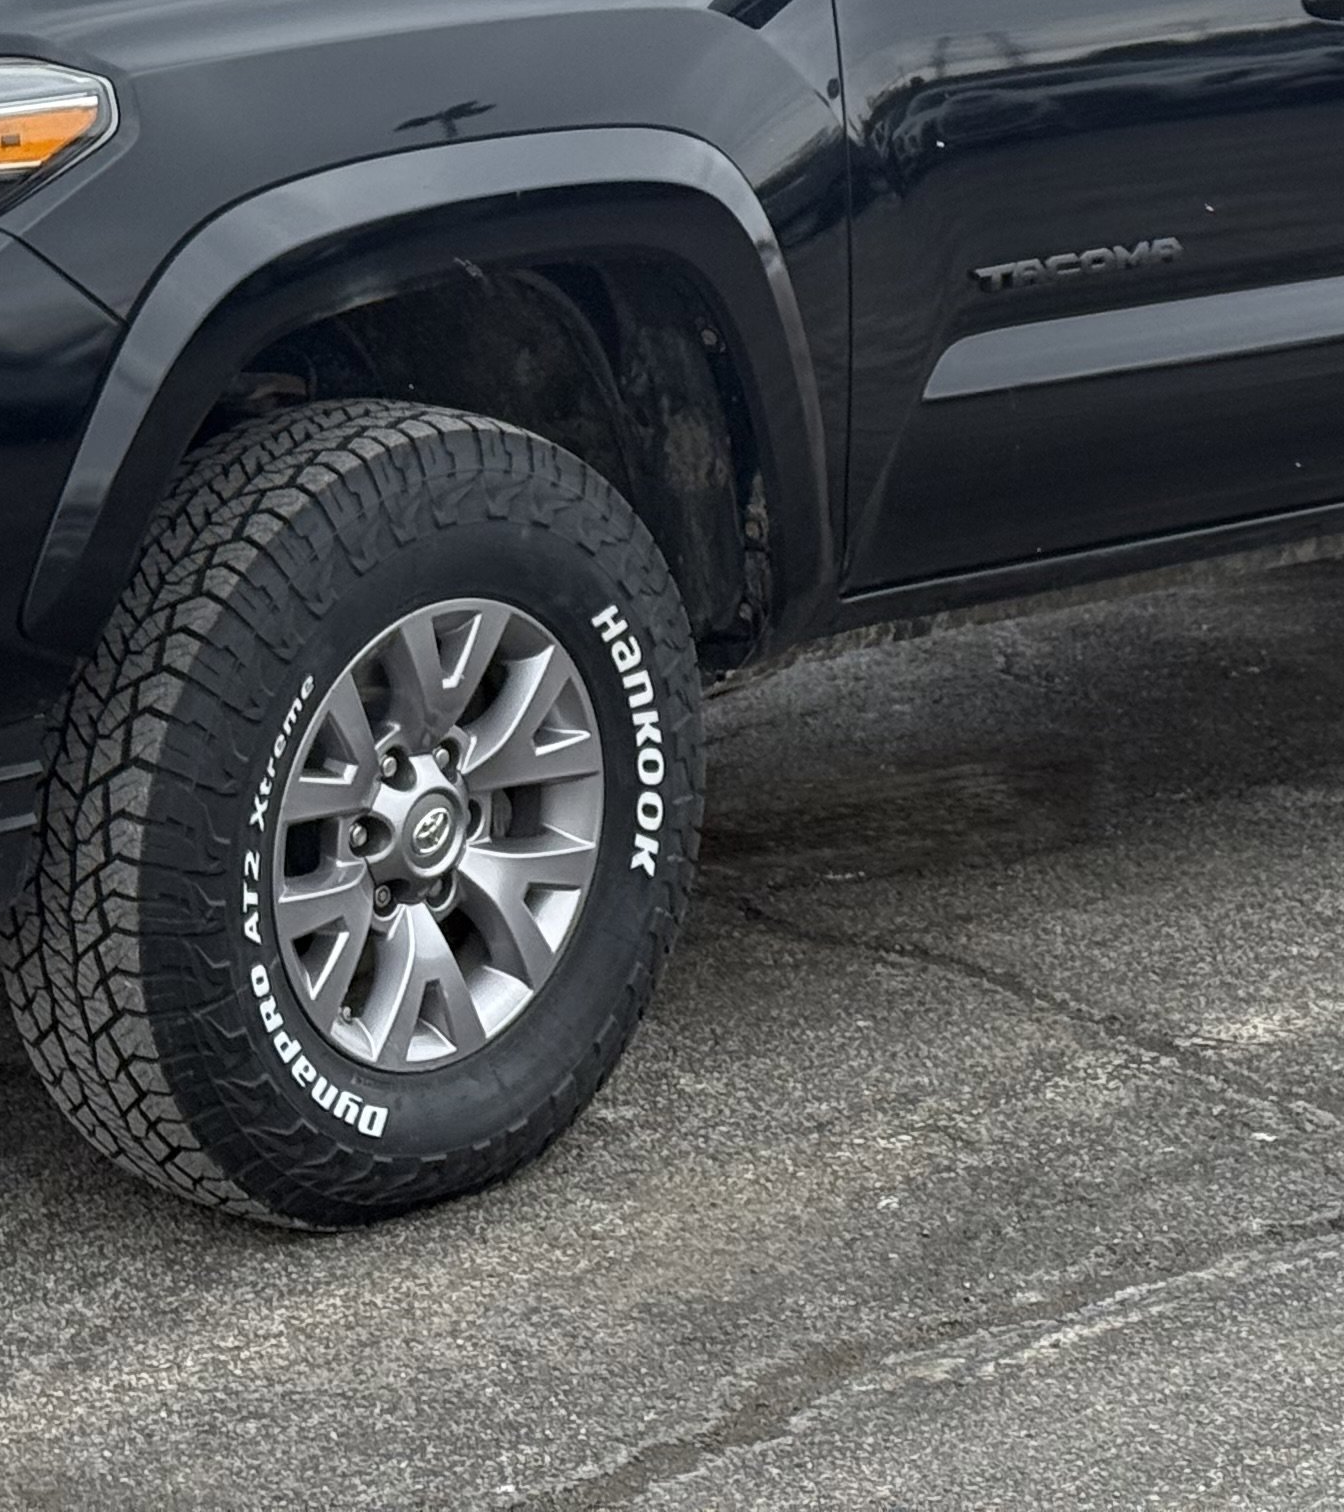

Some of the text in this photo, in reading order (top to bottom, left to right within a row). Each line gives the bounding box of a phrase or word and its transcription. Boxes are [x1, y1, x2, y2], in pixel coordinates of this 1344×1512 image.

[970, 237, 1184, 291] TACOMA
[249, 674, 316, 832] Xtreme
[242, 849, 263, 945] AT2
